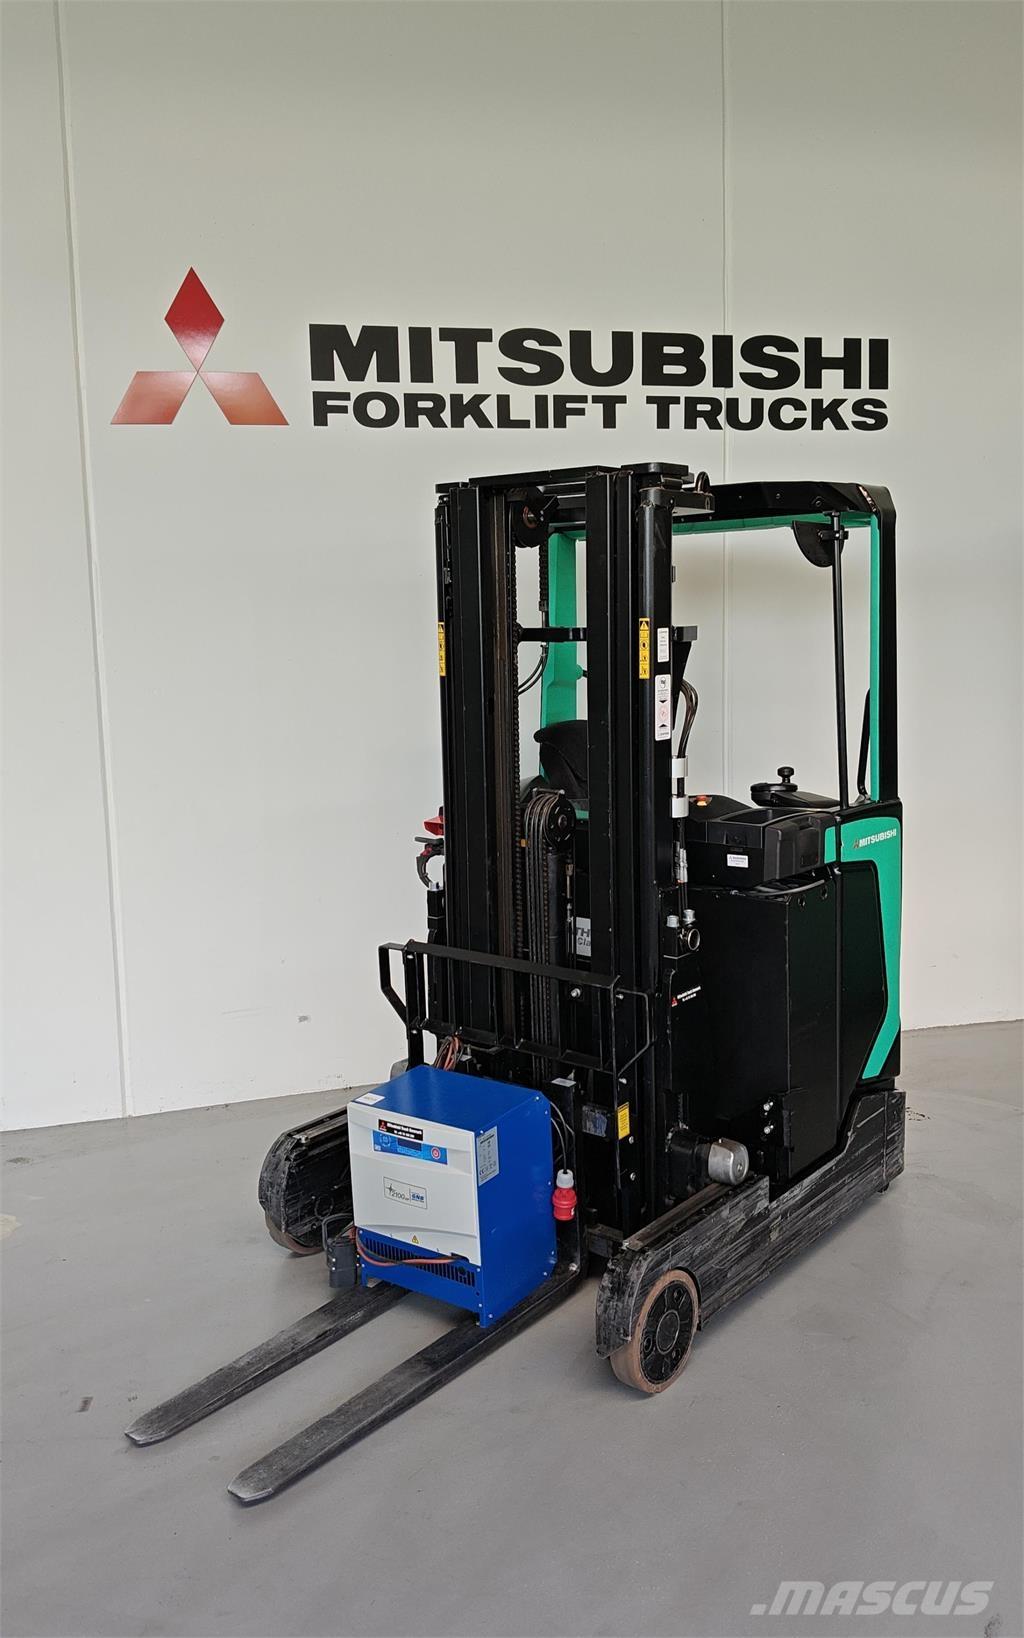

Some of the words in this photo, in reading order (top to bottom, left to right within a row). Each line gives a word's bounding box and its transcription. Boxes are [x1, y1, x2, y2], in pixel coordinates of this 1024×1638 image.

[309, 324, 889, 391] MITSUBISHI
[312, 391, 627, 429] FORKLIFT
[646, 395, 889, 431] TRUCKS
[859, 828, 897, 848] MITSUBISHI
